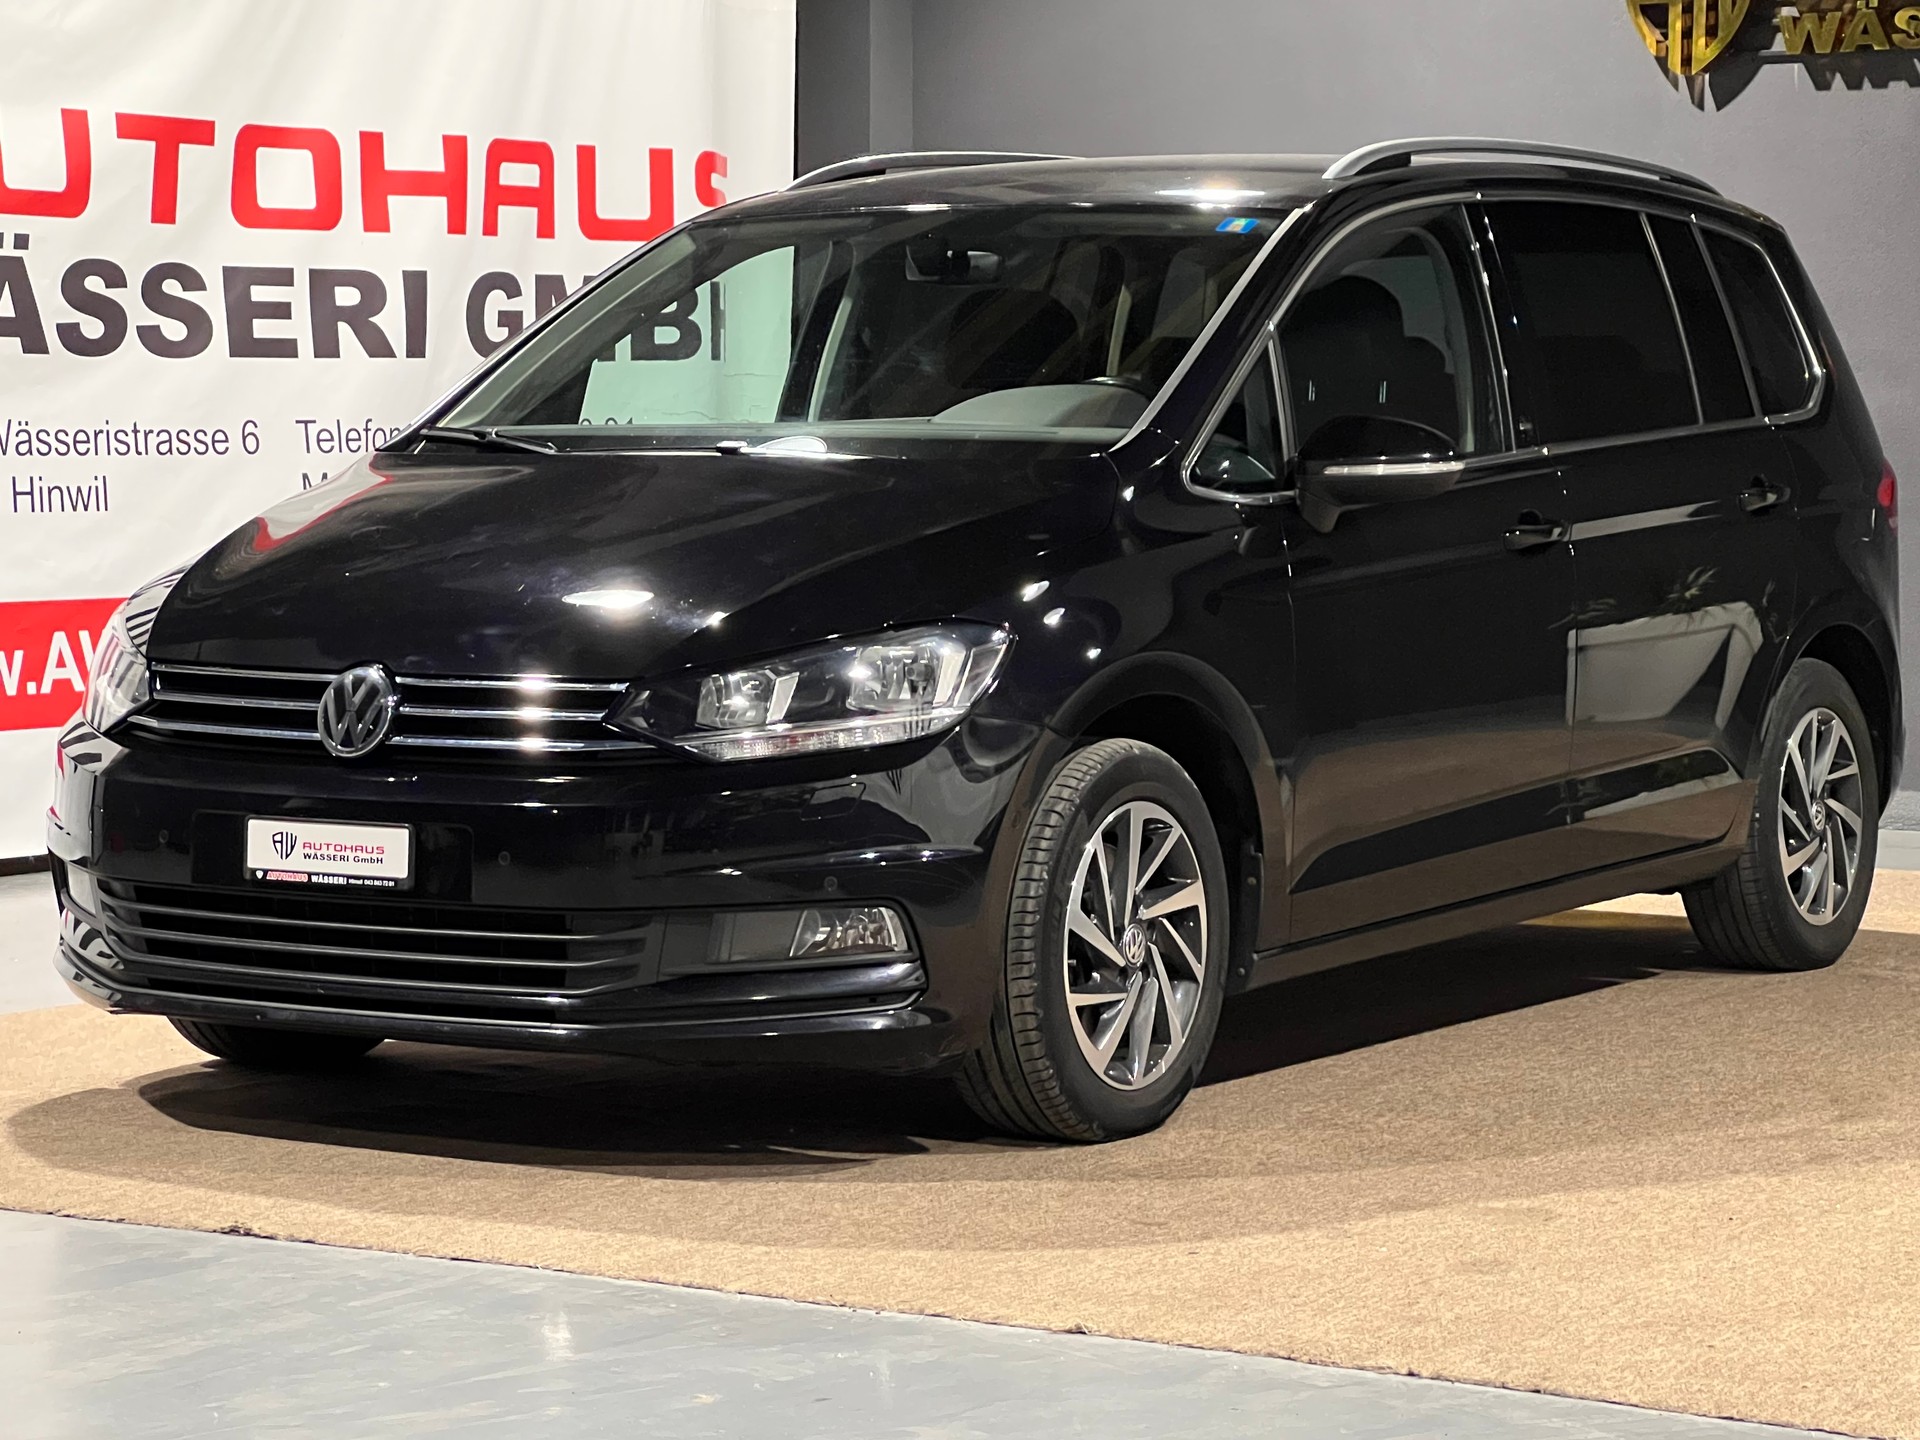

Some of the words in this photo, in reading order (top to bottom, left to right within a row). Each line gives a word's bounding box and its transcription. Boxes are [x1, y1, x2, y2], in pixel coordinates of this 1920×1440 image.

[241, 419, 260, 455] 6
[12, 475, 109, 513] Hinwil
[303, 841, 385, 855] AUTOHAUS
[303, 852, 349, 862] WÄSSERI
[353, 855, 383, 864] GmbH
[266, 871, 308, 882] AUTOHAUS
[311, 874, 347, 884] WÄSSERI
